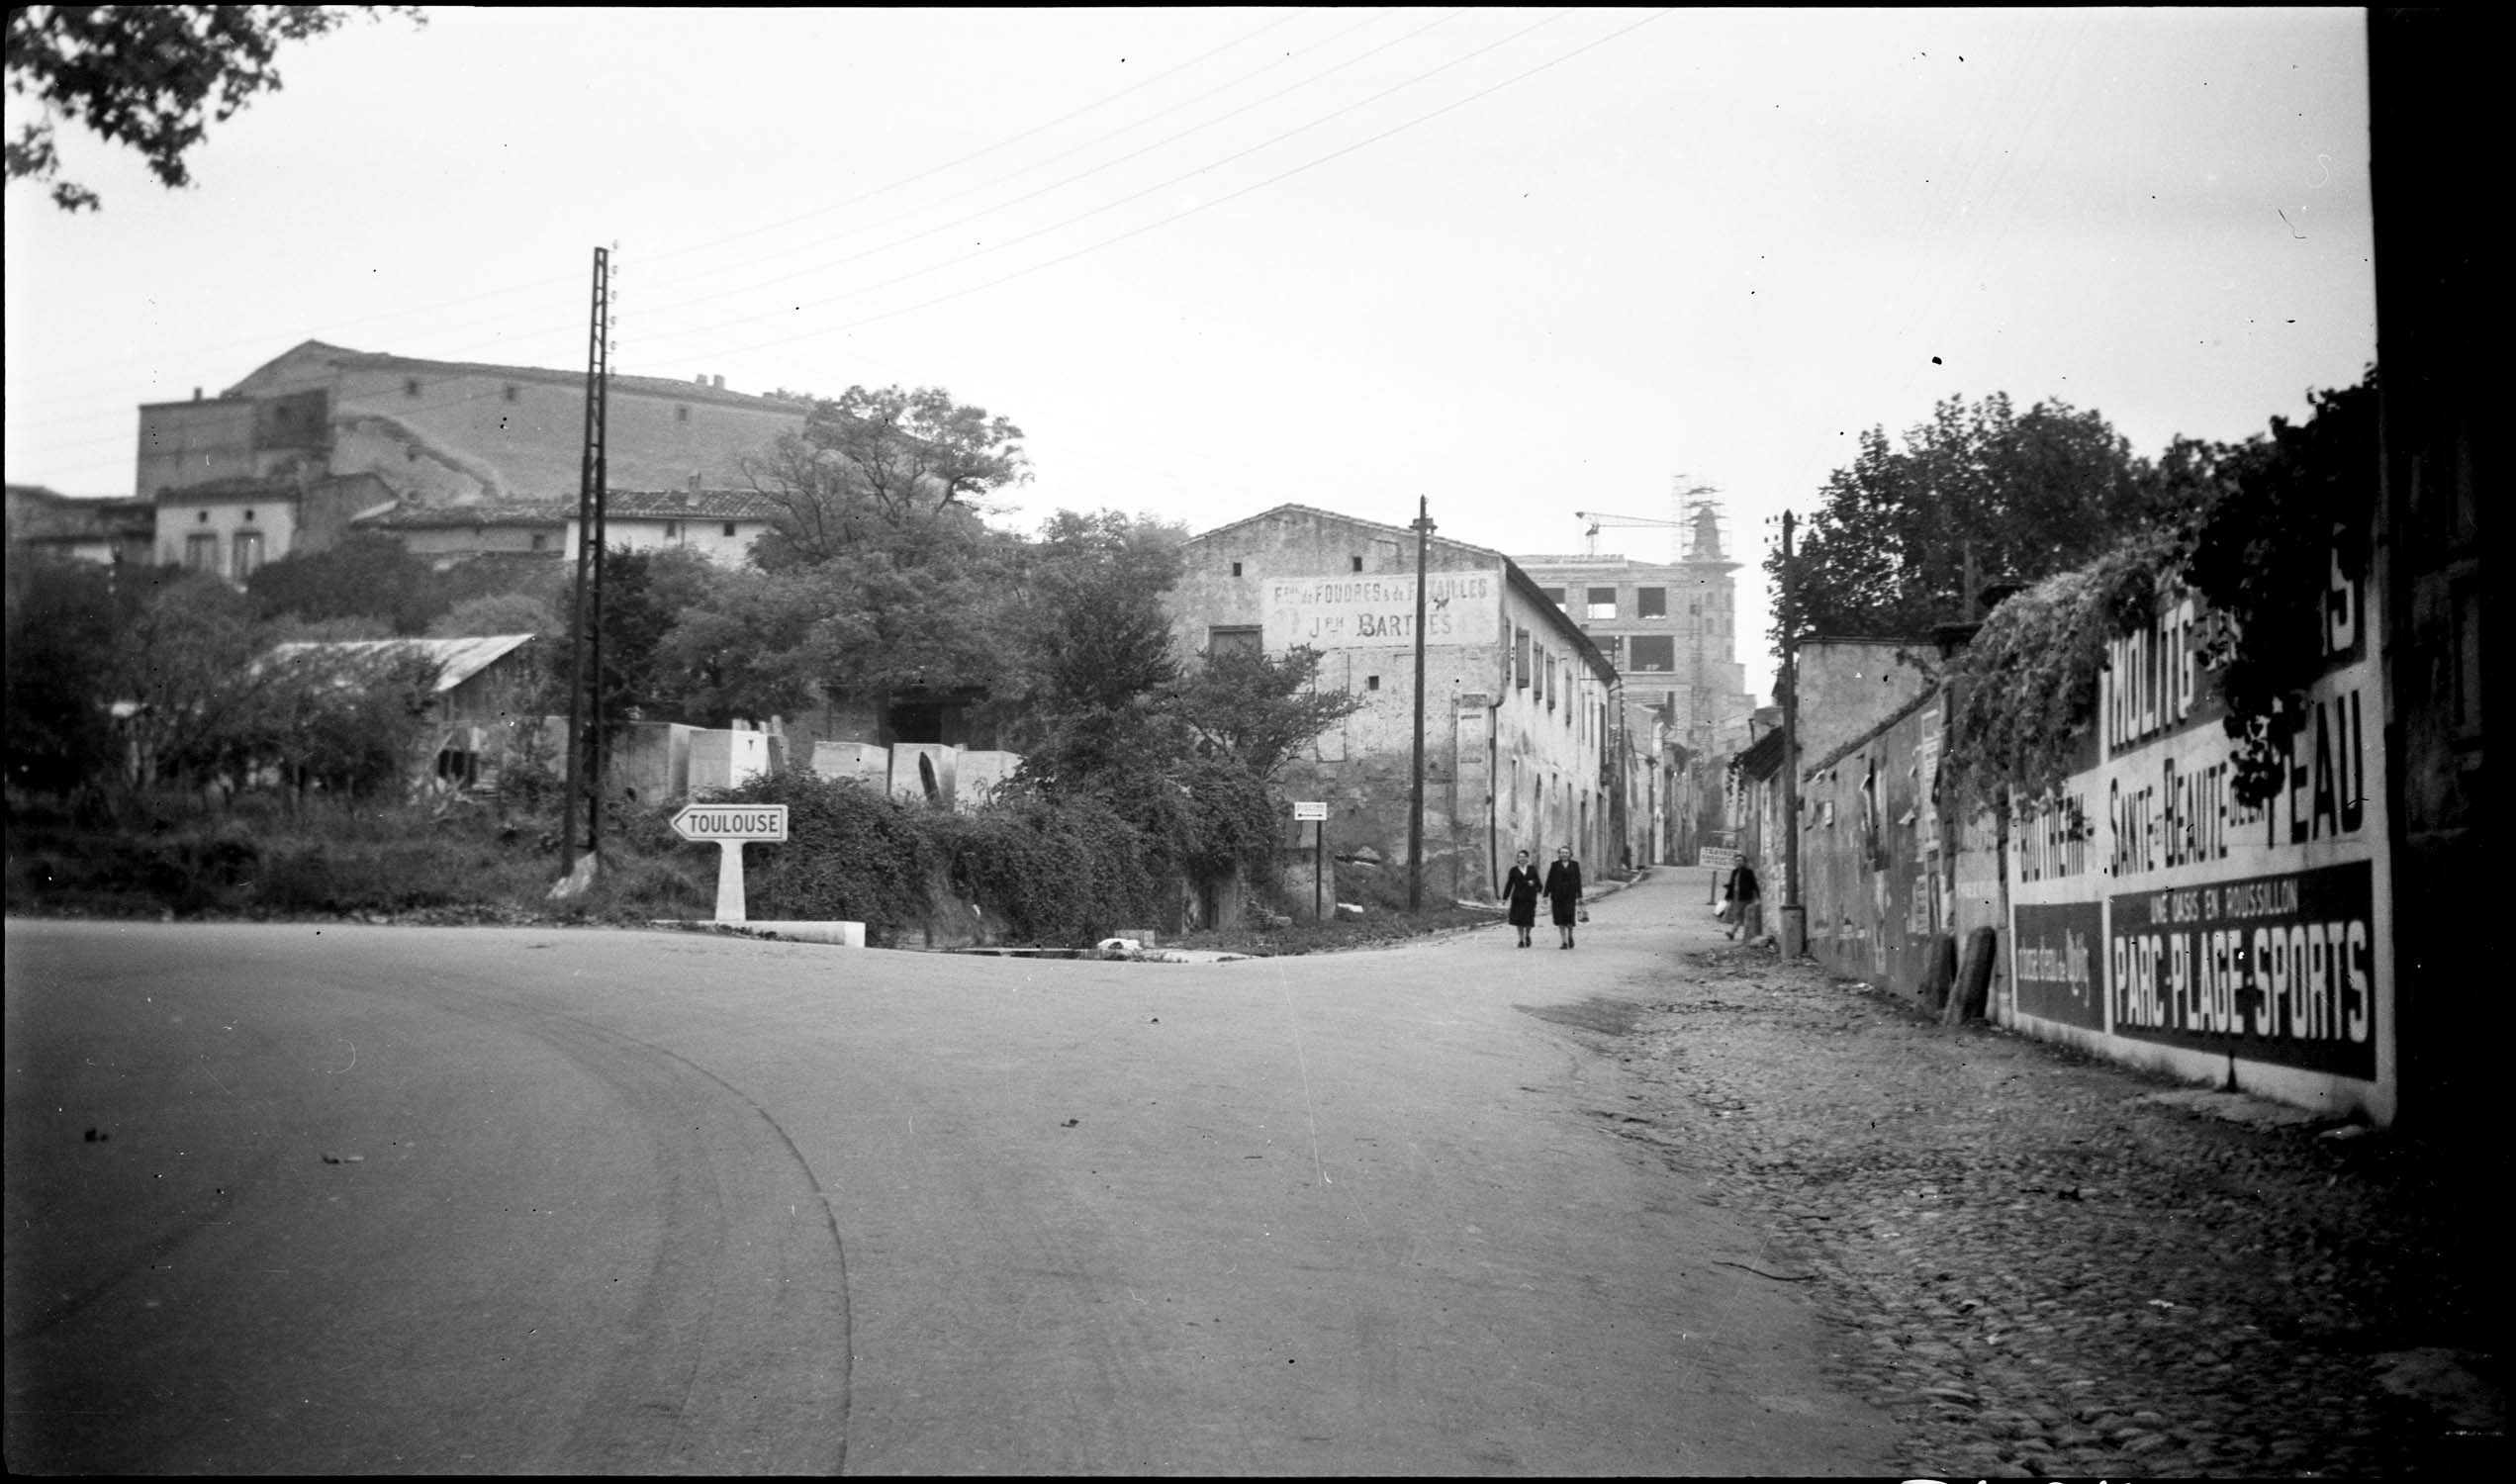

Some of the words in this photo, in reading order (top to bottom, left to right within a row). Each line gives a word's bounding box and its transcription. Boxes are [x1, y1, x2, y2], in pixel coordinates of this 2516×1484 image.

[1315, 582, 1381, 604] FOUDRES
[1355, 612, 1452, 638] BARTES
[2111, 599, 2194, 747] MOLITG
[689, 813, 779, 834] TOULOUSE
[2172, 890, 2199, 923] OASIS
[2203, 888, 2220, 921] EN
[2225, 878, 2298, 918] ROUSSILLON
